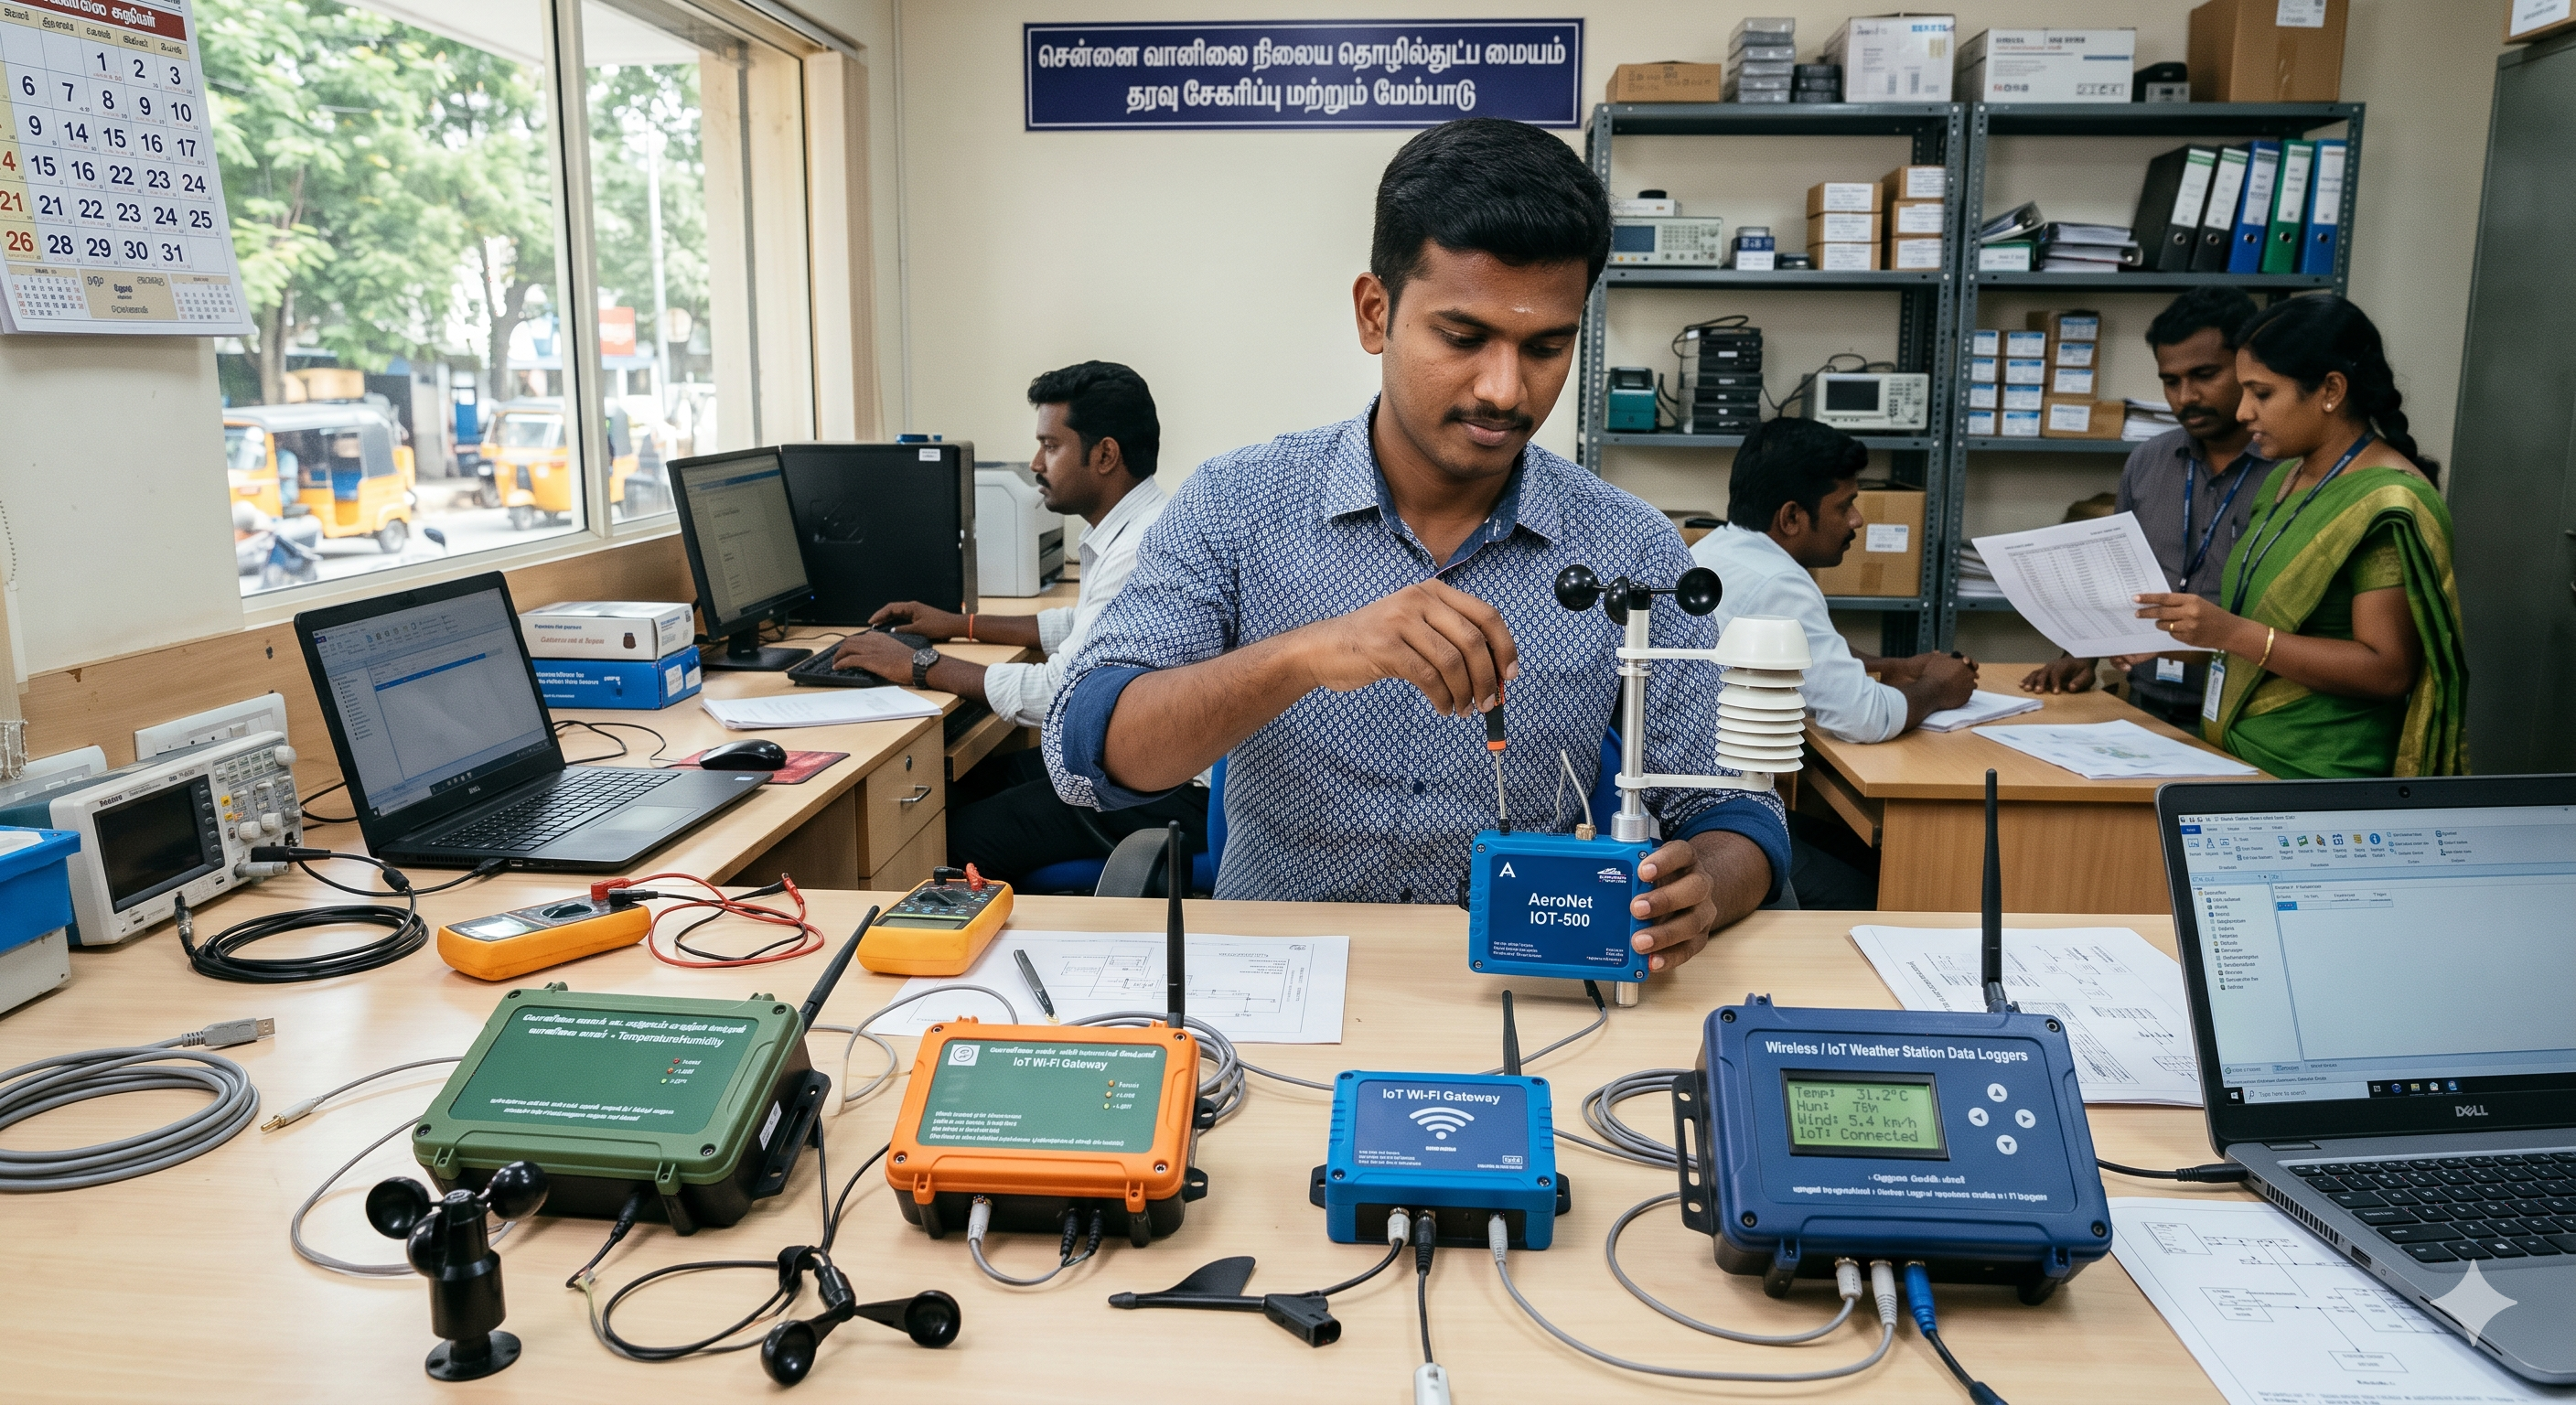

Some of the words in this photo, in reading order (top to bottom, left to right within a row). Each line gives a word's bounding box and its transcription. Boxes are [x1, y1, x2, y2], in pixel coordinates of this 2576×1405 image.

[1038, 38, 1139, 69] சென்னை
[1143, 38, 1248, 67] வானிலை
[1252, 37, 1333, 72] நிலைய
[1485, 35, 1566, 66] மையம்
[96, 51, 108, 71] 1
[133, 59, 146, 80] 2
[169, 66, 182, 85] 3
[22, 75, 37, 96] 6
[61, 81, 75, 103] 7
[102, 90, 115, 110] 8
[139, 96, 152, 116] 9
[170, 102, 193, 123] 10
[1126, 85, 1178, 114] தரவு
[1184, 77, 1282, 113] சேகரிப்பு
[1286, 77, 1368, 114] மற்றும்
[1374, 77, 1476, 111] மேம்பாடு
[28, 115, 43, 136] 9
[64, 121, 90, 144] 14
[102, 126, 127, 149] 15
[140, 133, 164, 155] 16
[177, 137, 197, 158] 17
[30, 155, 58, 177] 15
[70, 160, 96, 182] 16
[109, 165, 134, 187] 22
[146, 168, 172, 190] 23
[182, 173, 207, 194] 24
[0, 189, 24, 213] 21
[38, 194, 64, 216] 21
[78, 198, 105, 220] 22
[116, 202, 142, 223] 23
[153, 206, 178, 226] 24
[188, 209, 213, 230] 25
[5, 231, 35, 252] 26
[47, 234, 74, 255] 28
[86, 237, 112, 259] 29
[123, 240, 149, 262] 30
[161, 242, 184, 263] 31
[1499, 862, 1516, 878] A
[1528, 893, 1594, 908] AeroNet
[1530, 912, 1590, 928] IOT-500
[1766, 1041, 1819, 1056] Wireless
[1820, 1043, 1826, 1056] /
[1828, 1043, 1847, 1056] IoT
[1849, 1044, 1900, 1058] Weather
[1902, 1045, 1946, 1059] Station
[1948, 1046, 1975, 1060] Data
[1978, 1047, 2028, 1064] Loggers
[1014, 1057, 1032, 1067] IoT
[1061, 1059, 1108, 1072] Gateway
[1382, 1089, 1404, 1099] IoT
[1444, 1090, 1500, 1106] Gateway
[1795, 1086, 1835, 1099] Temp:
[1798, 1113, 1839, 1127] Wind:
[1849, 1114, 1875, 1127] 5.4
[1883, 1116, 1917, 1129] km/h
[2454, 1105, 2488, 1117] DELL
[1840, 1129, 1918, 1142] Connected
